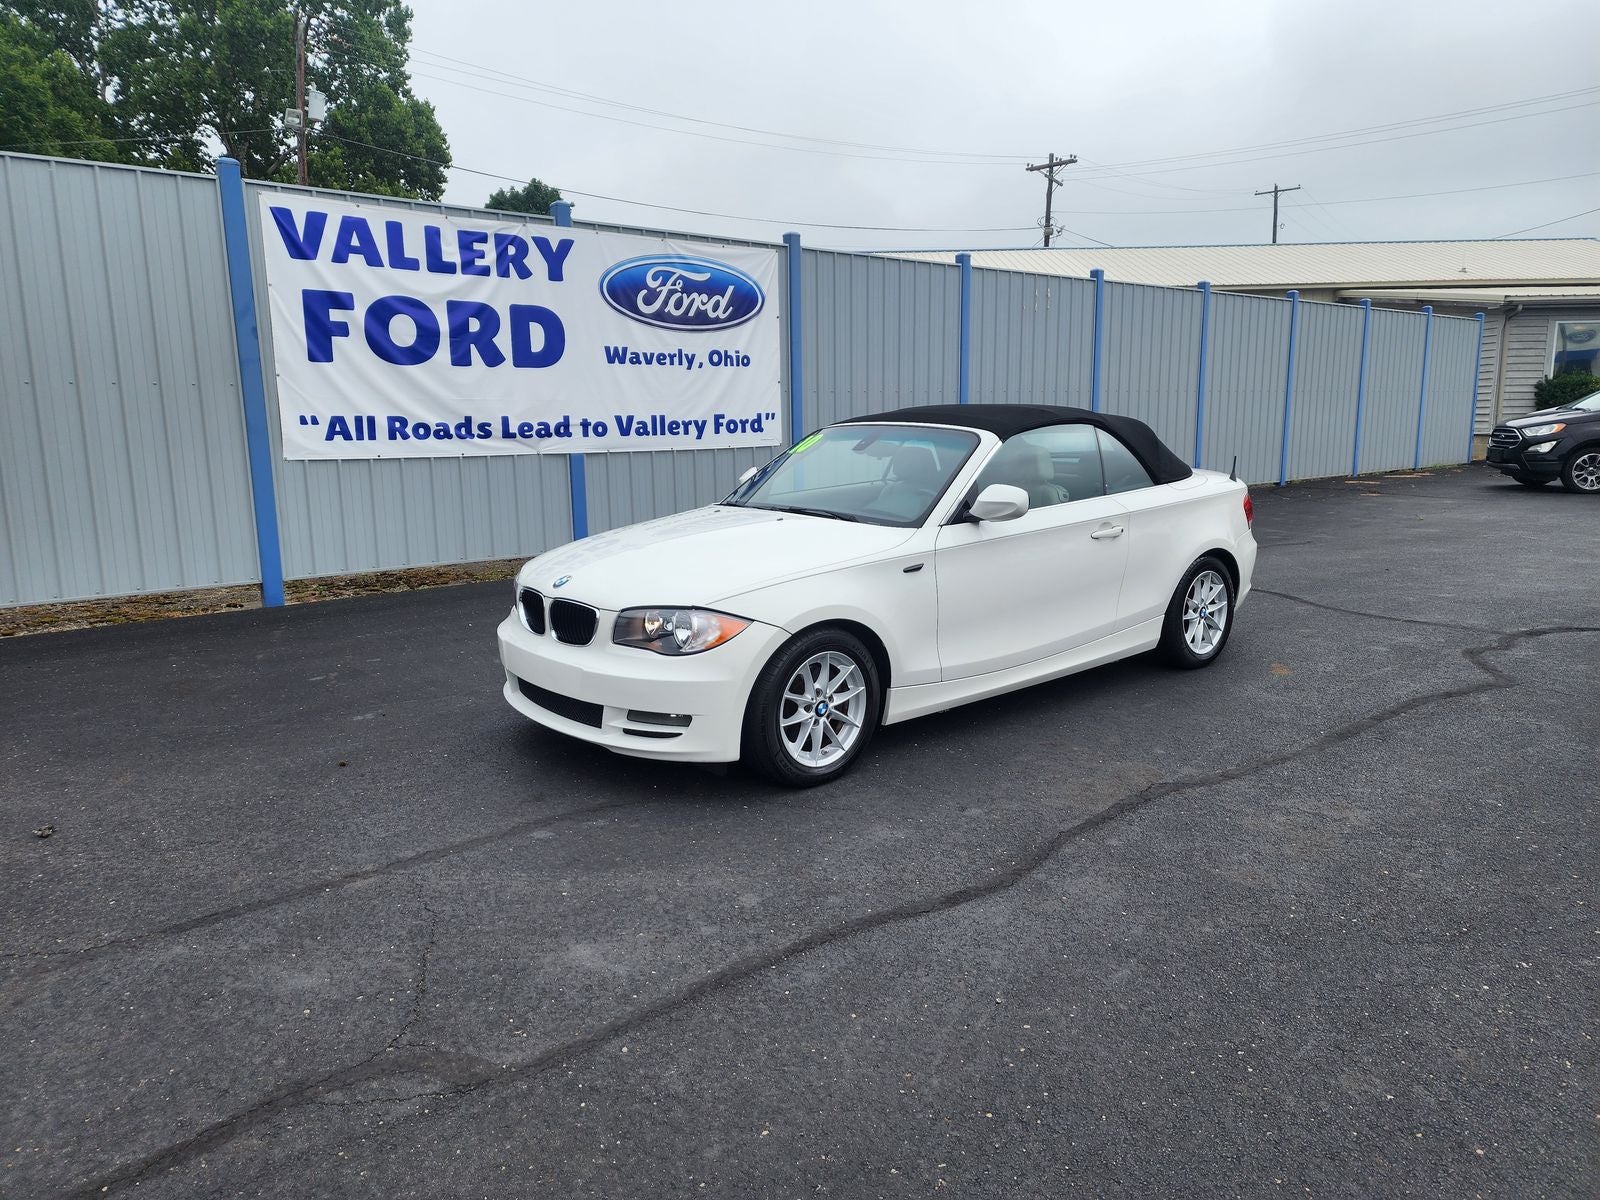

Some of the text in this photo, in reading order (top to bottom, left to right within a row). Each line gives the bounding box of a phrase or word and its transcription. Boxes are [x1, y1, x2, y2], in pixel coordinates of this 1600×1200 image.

[269, 206, 575, 282] VALLERY
[636, 265, 735, 321] Ford
[301, 288, 567, 369] FORD
[604, 345, 751, 371] Waverly, Ohio
[386, 415, 493, 441] Roads
[501, 415, 573, 440] Lead
[579, 418, 609, 438] to
[613, 413, 708, 440] Vallery
